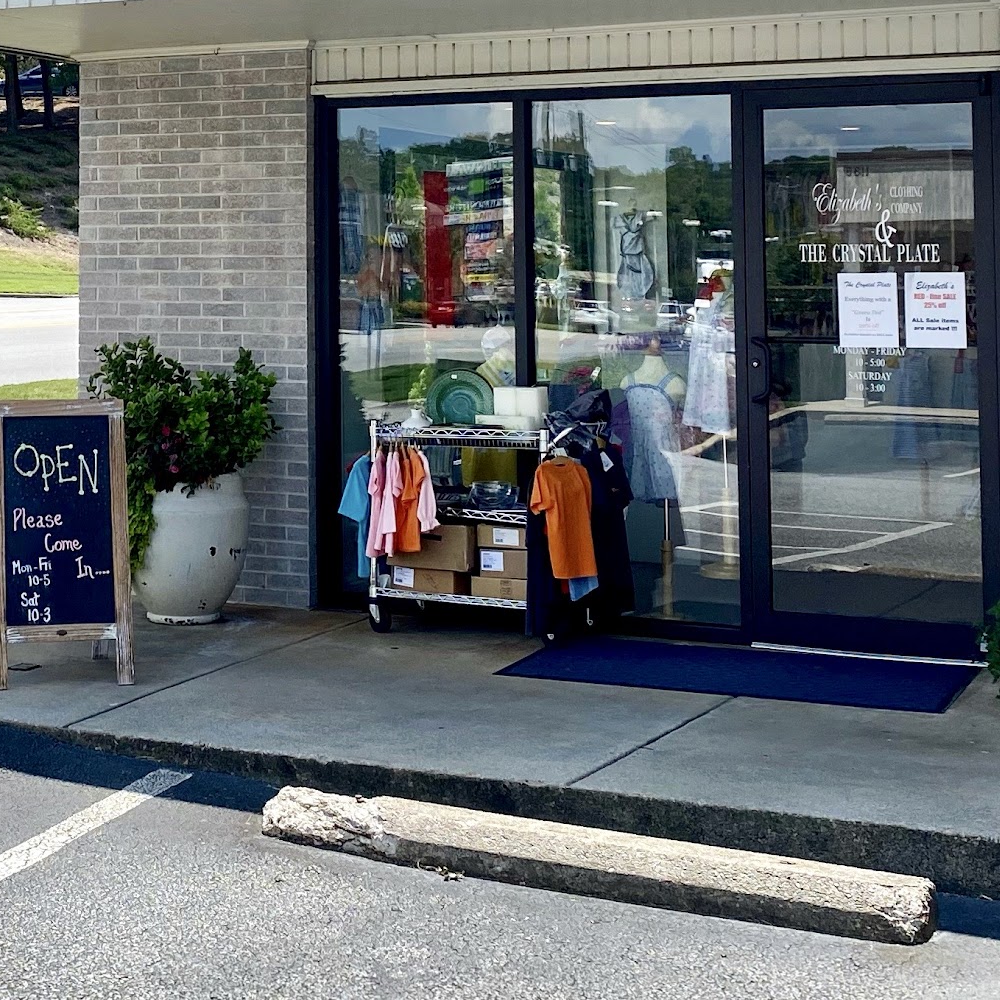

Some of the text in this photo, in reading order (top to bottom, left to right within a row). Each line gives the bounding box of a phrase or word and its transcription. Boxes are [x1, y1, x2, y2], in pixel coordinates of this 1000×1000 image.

[890, 186, 923, 198] CLOTHING
[812, 182, 882, 225] Elizabeth's
[891, 202, 923, 214] COMPANY
[875, 209, 897, 248] &
[799, 243, 940, 263] THE CRYSTAL PLATE
[833, 346, 869, 355] MONDAY
[876, 347, 907, 356] FRIDAY
[855, 358, 864, 367] 10
[870, 358, 886, 367] 5:00
[848, 371, 892, 381] SATURDAY
[855, 383, 864, 392] 10
[870, 384, 886, 393] 3:00
[13, 443, 99, 496] OPEN
[12, 507, 63, 532] Please
[44, 533, 82, 553] Come
[28, 573, 51, 587] 10-5
[20, 591, 41, 608] Sat
[27, 607, 51, 623] 10-3
